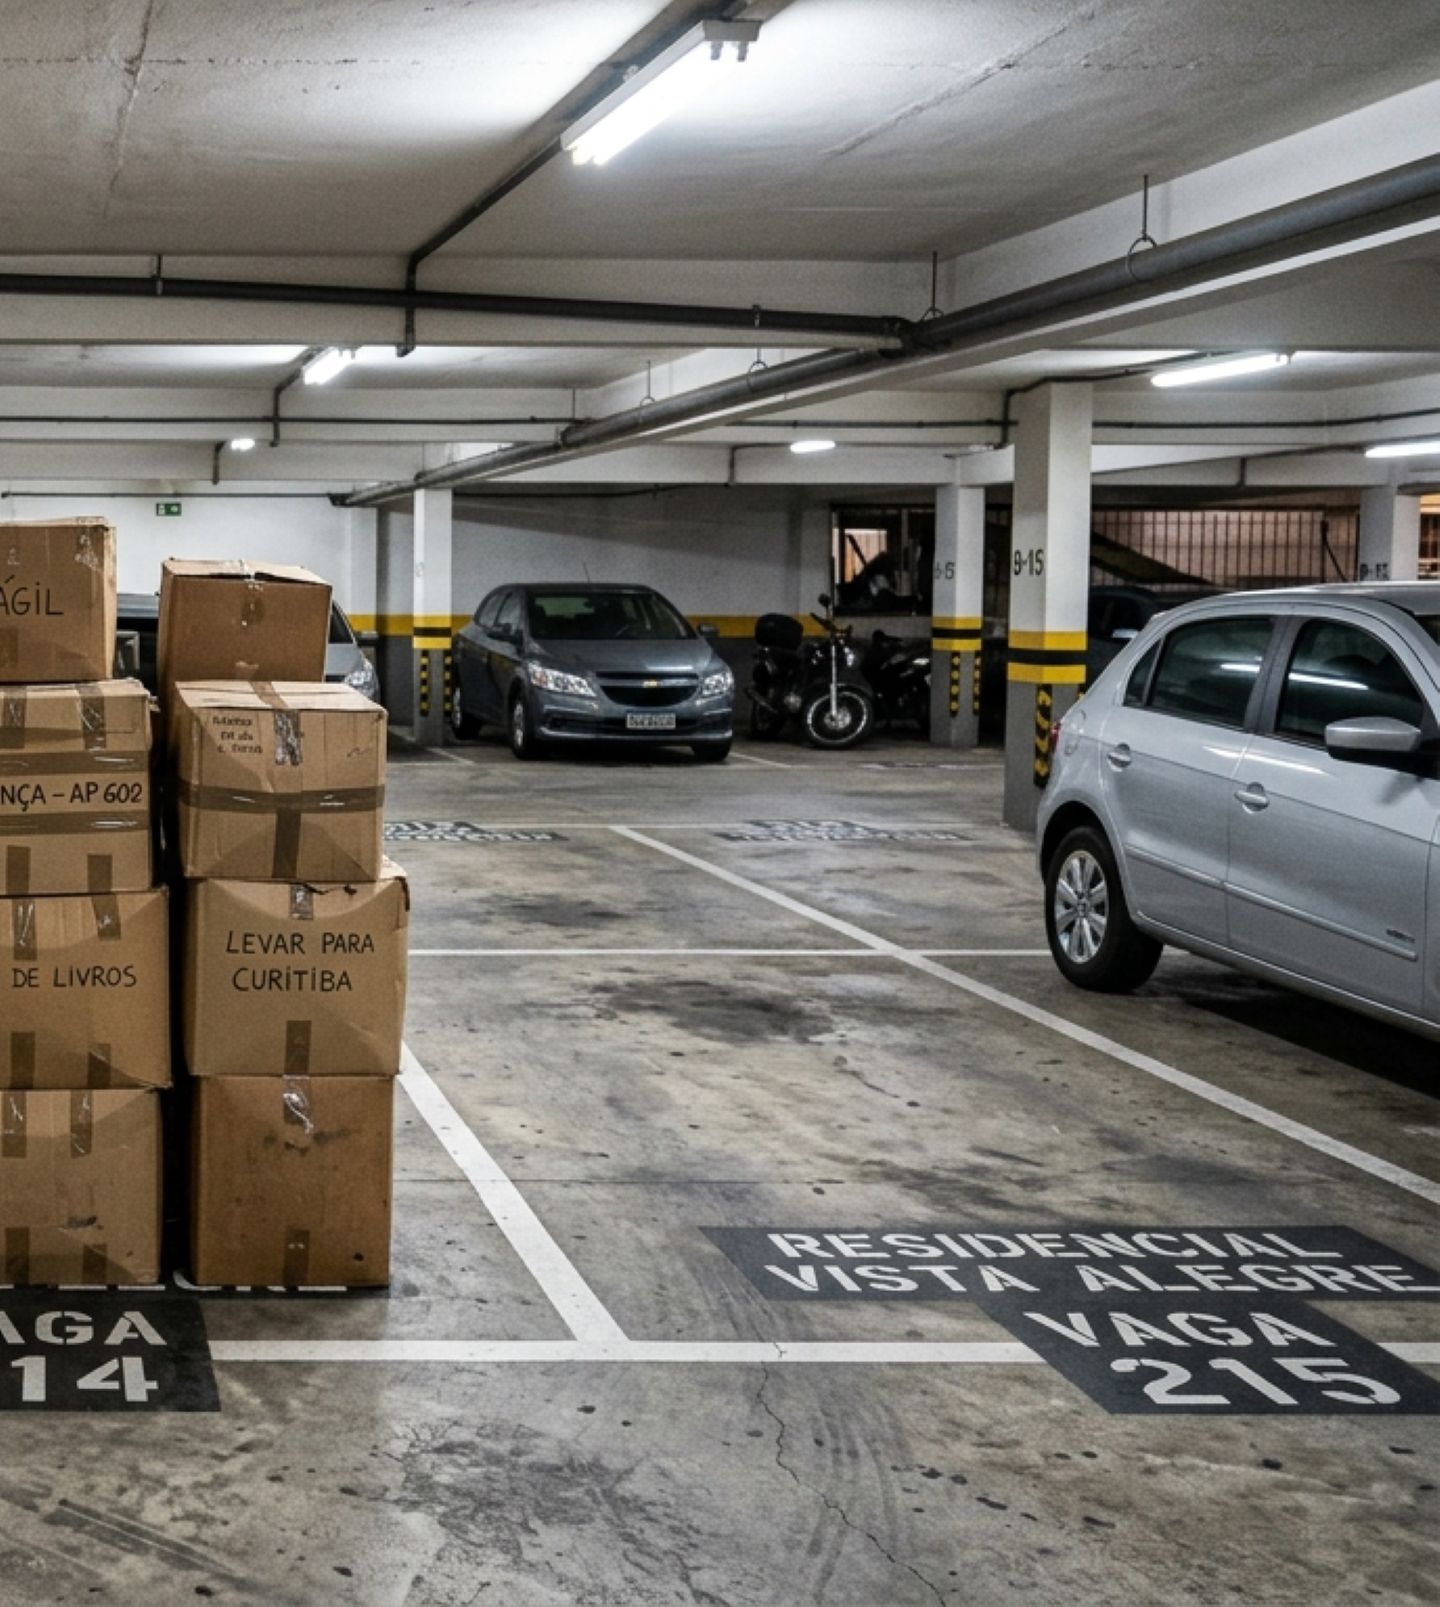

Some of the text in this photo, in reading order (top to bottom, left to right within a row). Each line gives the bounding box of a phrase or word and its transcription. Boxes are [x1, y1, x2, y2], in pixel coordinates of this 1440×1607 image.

[70, 781, 98, 804] AP
[103, 782, 143, 804] 602
[225, 930, 375, 955] LEVAR PARA
[12, 967, 40, 988] DE
[53, 964, 137, 988] LIVROS
[232, 965, 353, 992] CURITIBA
[766, 1233, 1344, 1259] RESIDENCIAL
[764, 1265, 1440, 1293] VISTA ALEGRE
[1022, 1312, 1339, 1348] VAGA
[1109, 1357, 1402, 1406] 215
